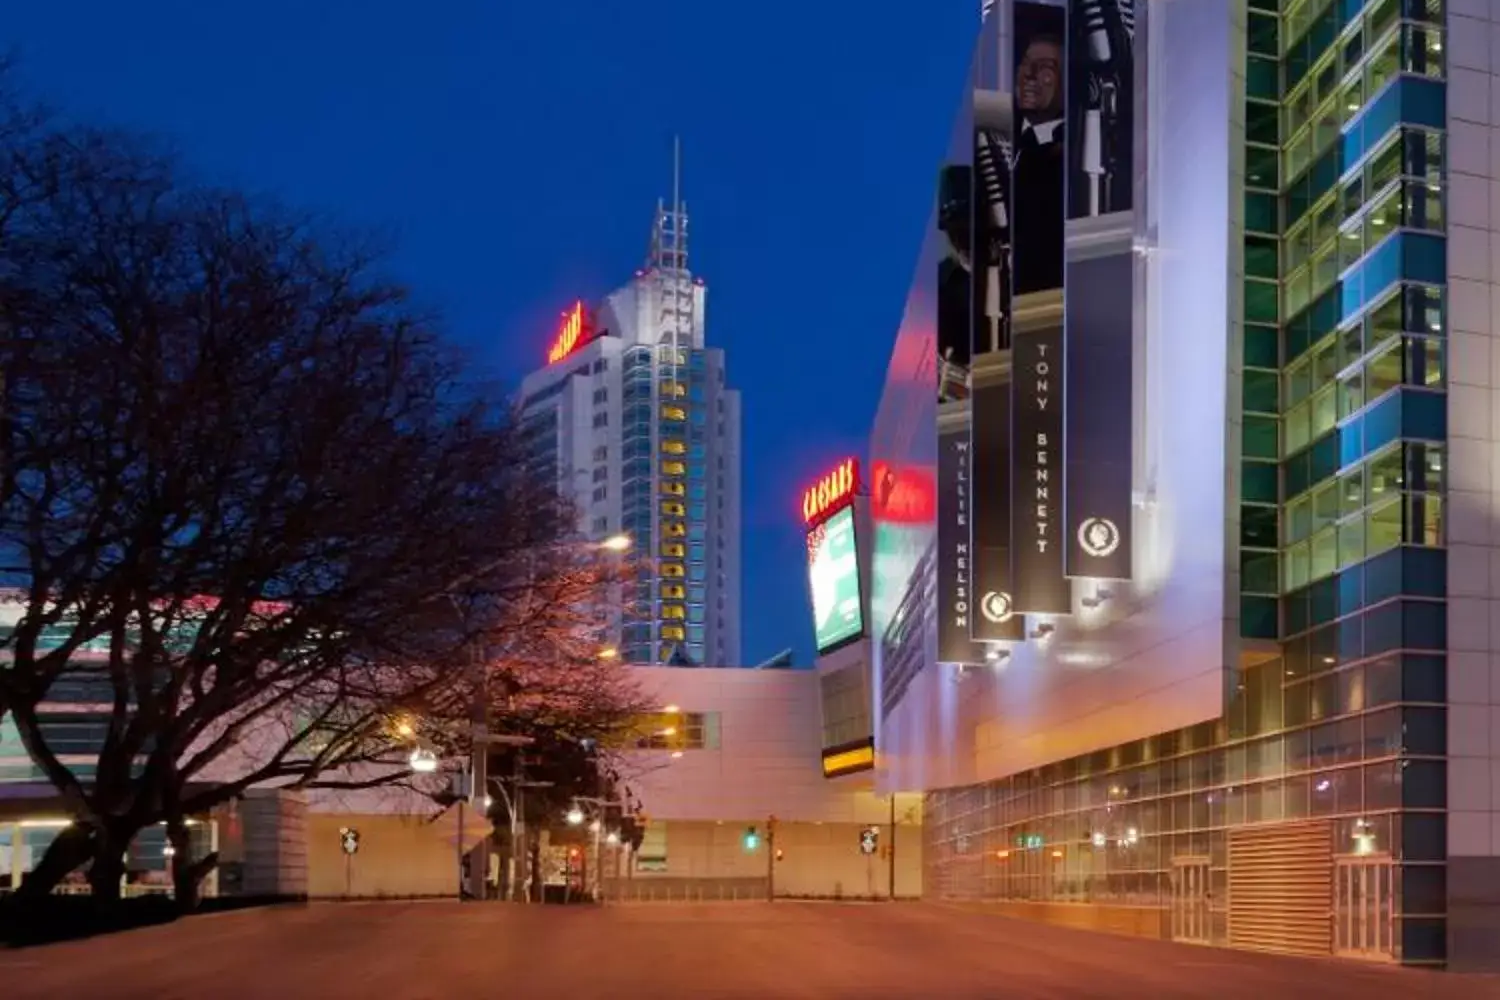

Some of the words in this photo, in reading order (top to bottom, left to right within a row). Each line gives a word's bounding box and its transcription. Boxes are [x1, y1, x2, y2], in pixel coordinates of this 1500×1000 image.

[1036, 344, 1049, 410] TONY
[956, 442, 968, 526] WILLIE
[1036, 432, 1049, 553] BENNETT
[955, 543, 968, 627] NELSON
